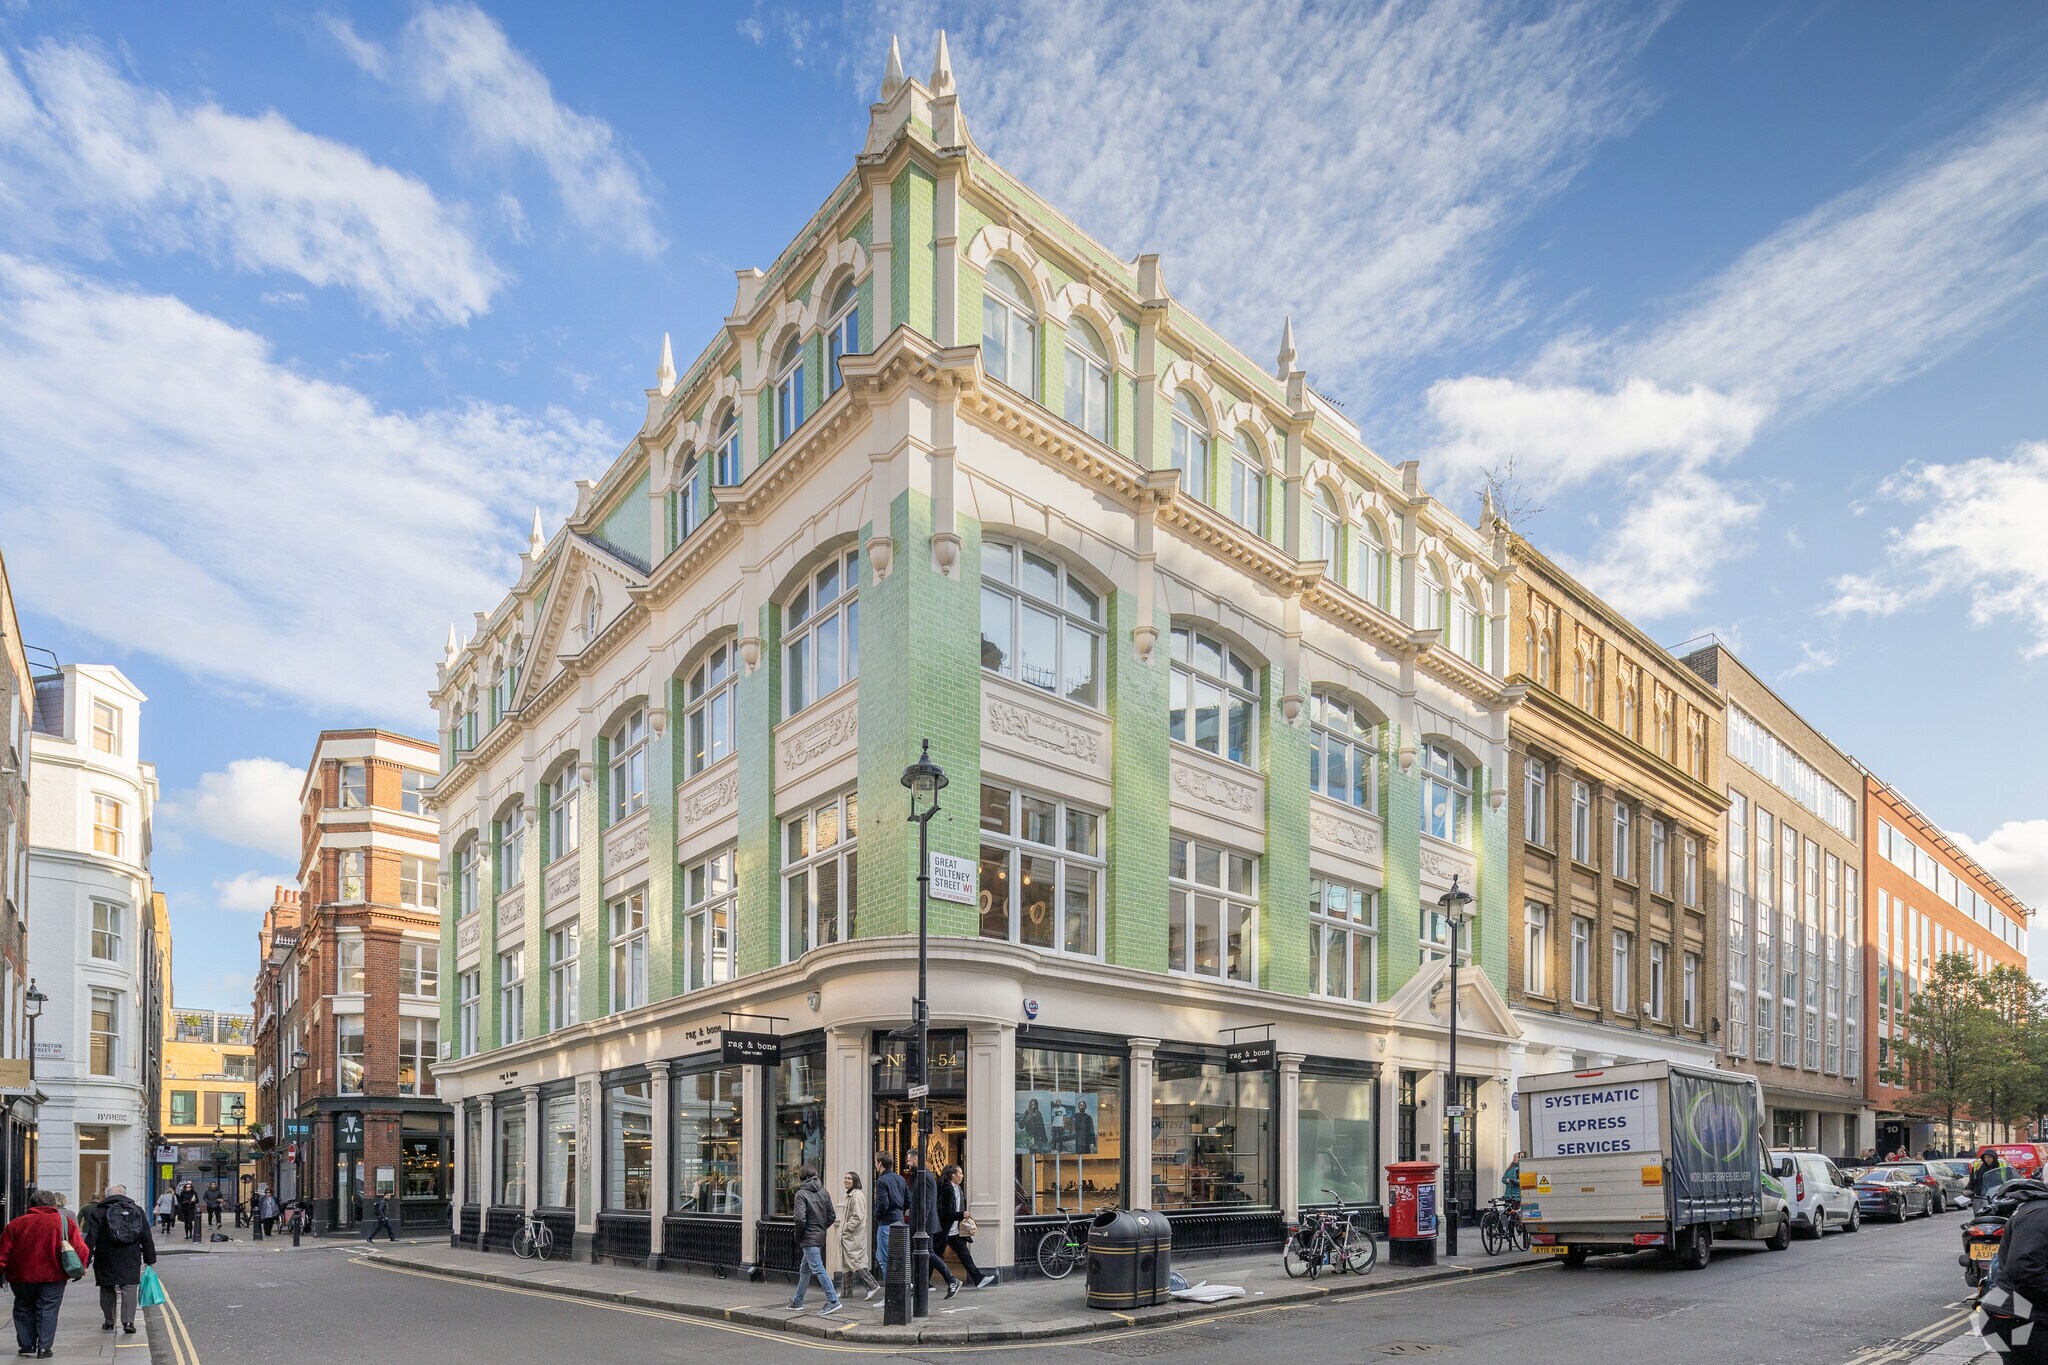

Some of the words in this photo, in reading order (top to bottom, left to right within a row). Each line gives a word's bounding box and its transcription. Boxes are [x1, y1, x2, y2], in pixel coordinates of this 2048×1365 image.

[934, 856, 957, 869] GREAT
[934, 867, 970, 882] PULTENEY
[934, 878, 960, 890] STREET
[963, 883, 972, 893] W1
[685, 1030, 696, 1039] rag
[699, 1027, 704, 1036] &
[706, 1025, 722, 1034] bone
[727, 1041, 743, 1049] rag
[747, 1041, 753, 1049] &
[757, 1042, 777, 1050] bone
[1545, 1088, 1639, 1109] SYSTEMATIC
[1558, 1116, 1627, 1132] EXPRESS
[1557, 1139, 1631, 1155] SERVICES
